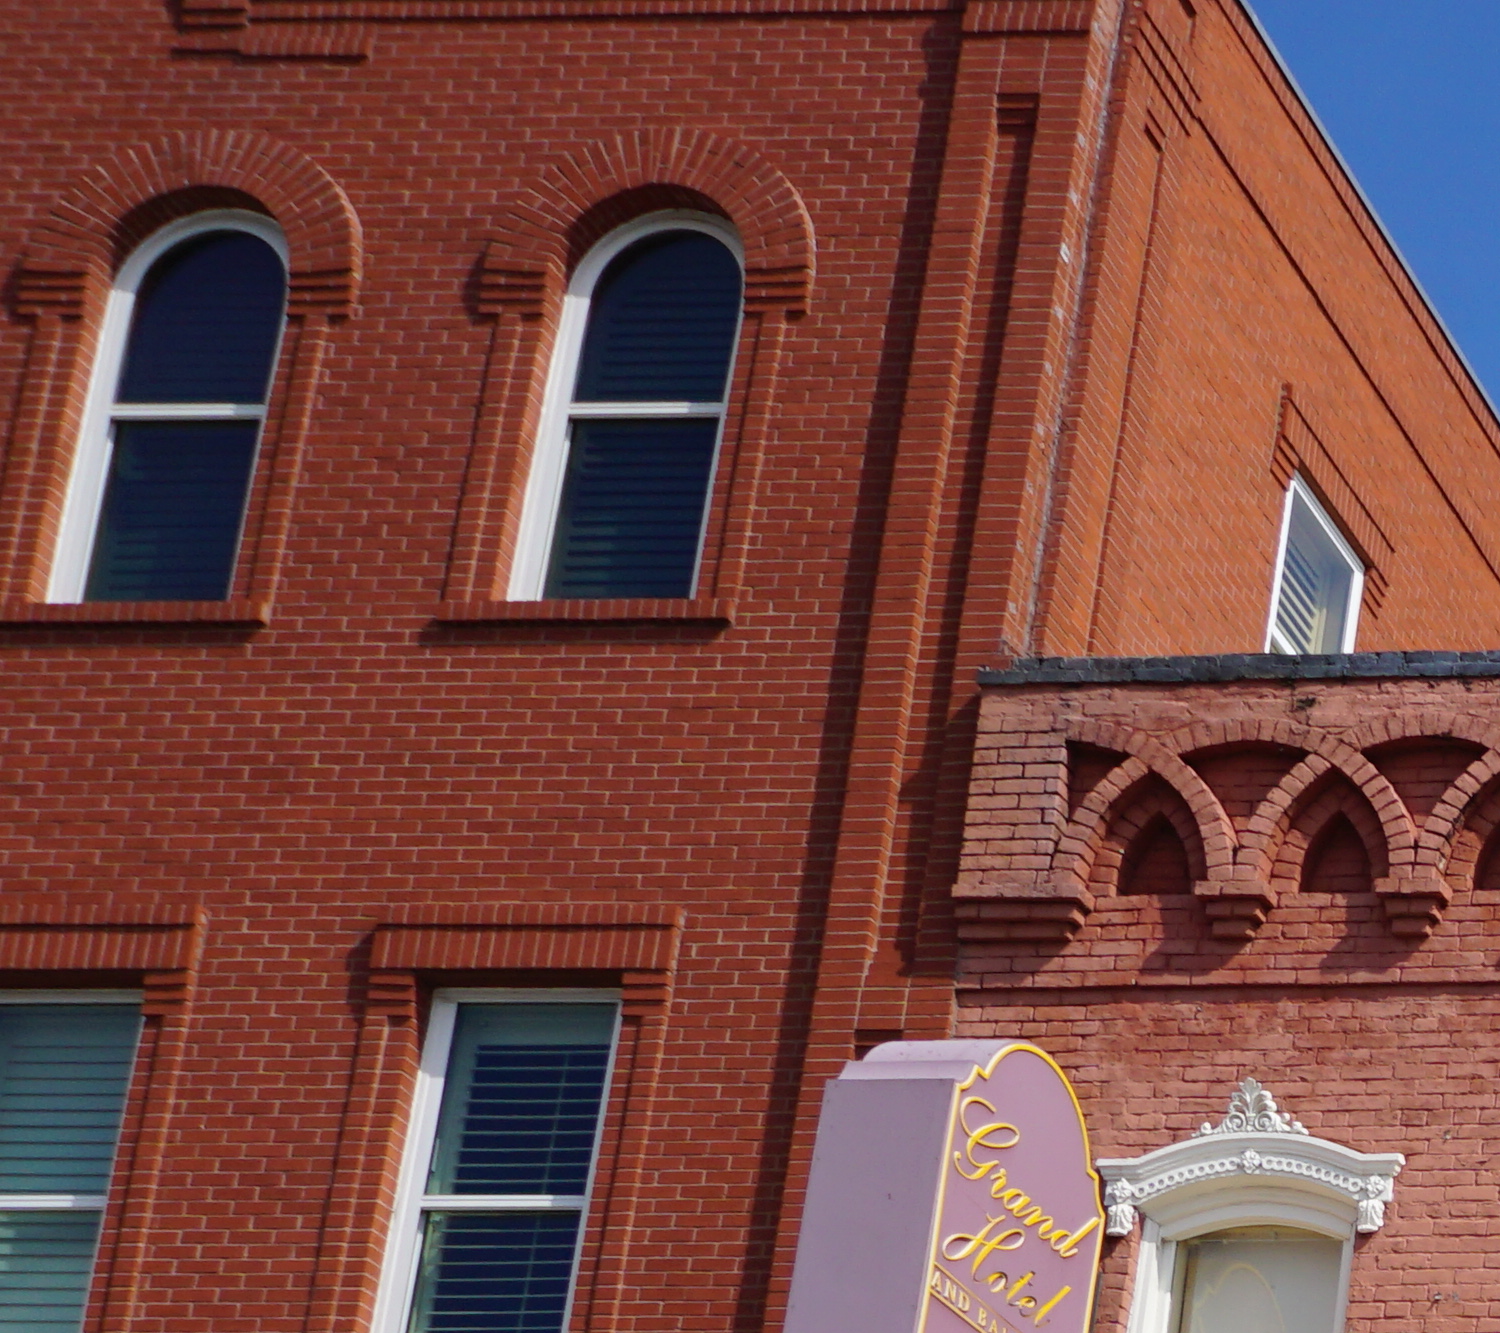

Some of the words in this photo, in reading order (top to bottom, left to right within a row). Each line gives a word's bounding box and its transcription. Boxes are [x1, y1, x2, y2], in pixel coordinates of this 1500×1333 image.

[954, 1096, 1100, 1258] Grand
[931, 1271, 971, 1312] AND
[942, 1213, 1071, 1328] Hotel
